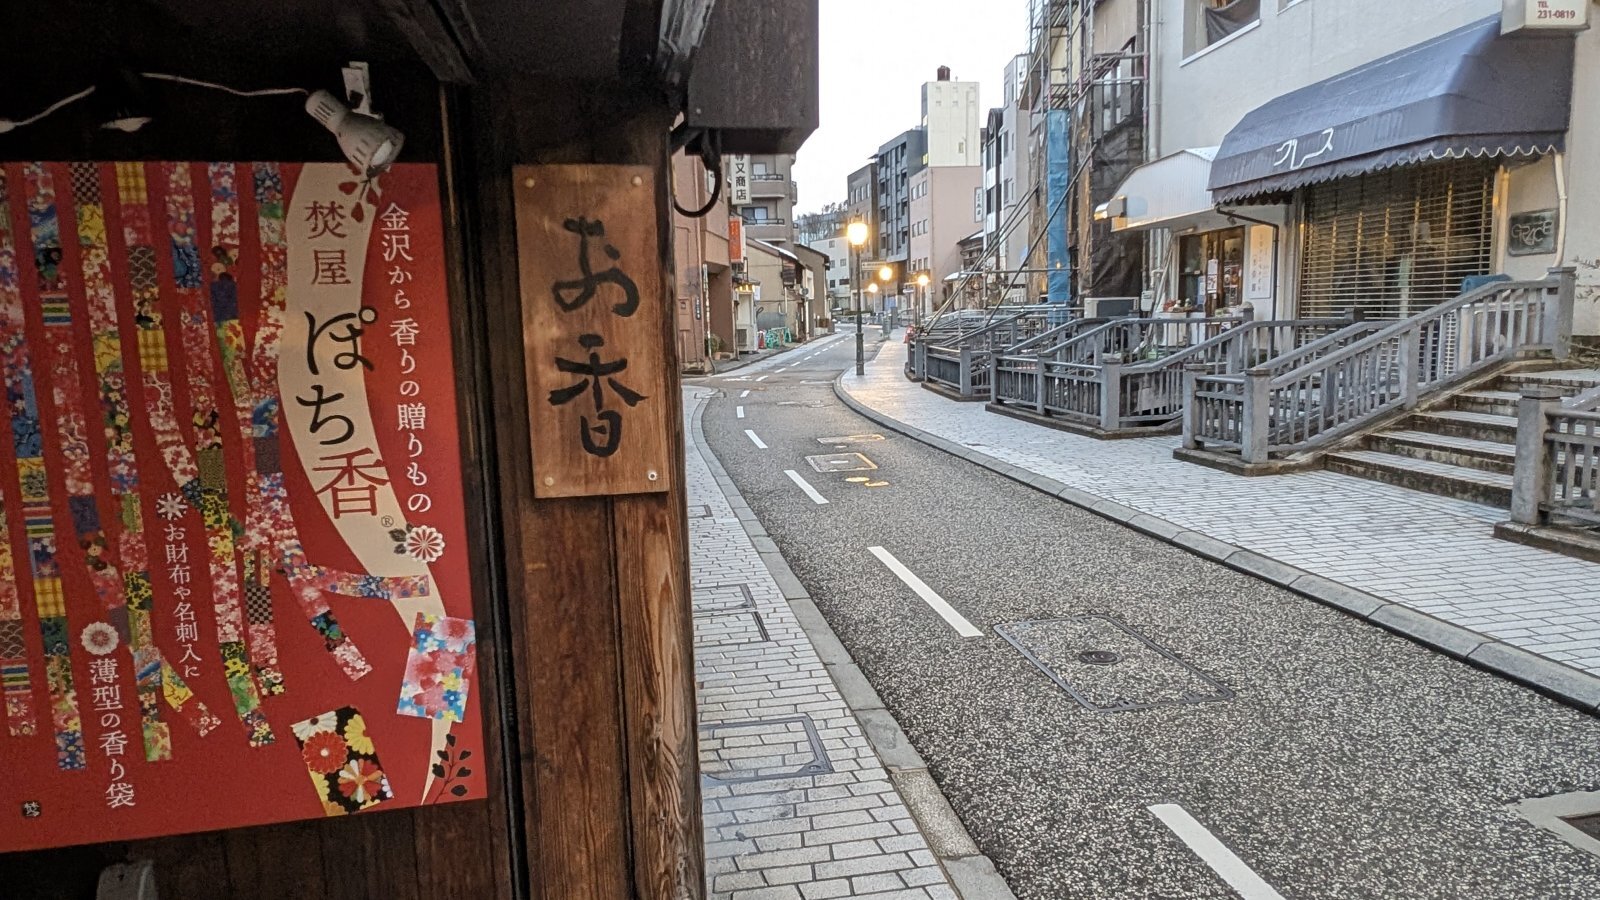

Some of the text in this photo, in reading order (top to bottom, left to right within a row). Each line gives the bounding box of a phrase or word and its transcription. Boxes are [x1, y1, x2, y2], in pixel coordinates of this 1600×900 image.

[1537, 10, 1576, 19] 231-0819
[380, 202, 432, 513] 金沢から香りの贈りもの
[547, 216, 650, 458] お香
[163, 523, 202, 678] お財布や名刺入に
[88, 657, 137, 809] 薄型の香り袋
